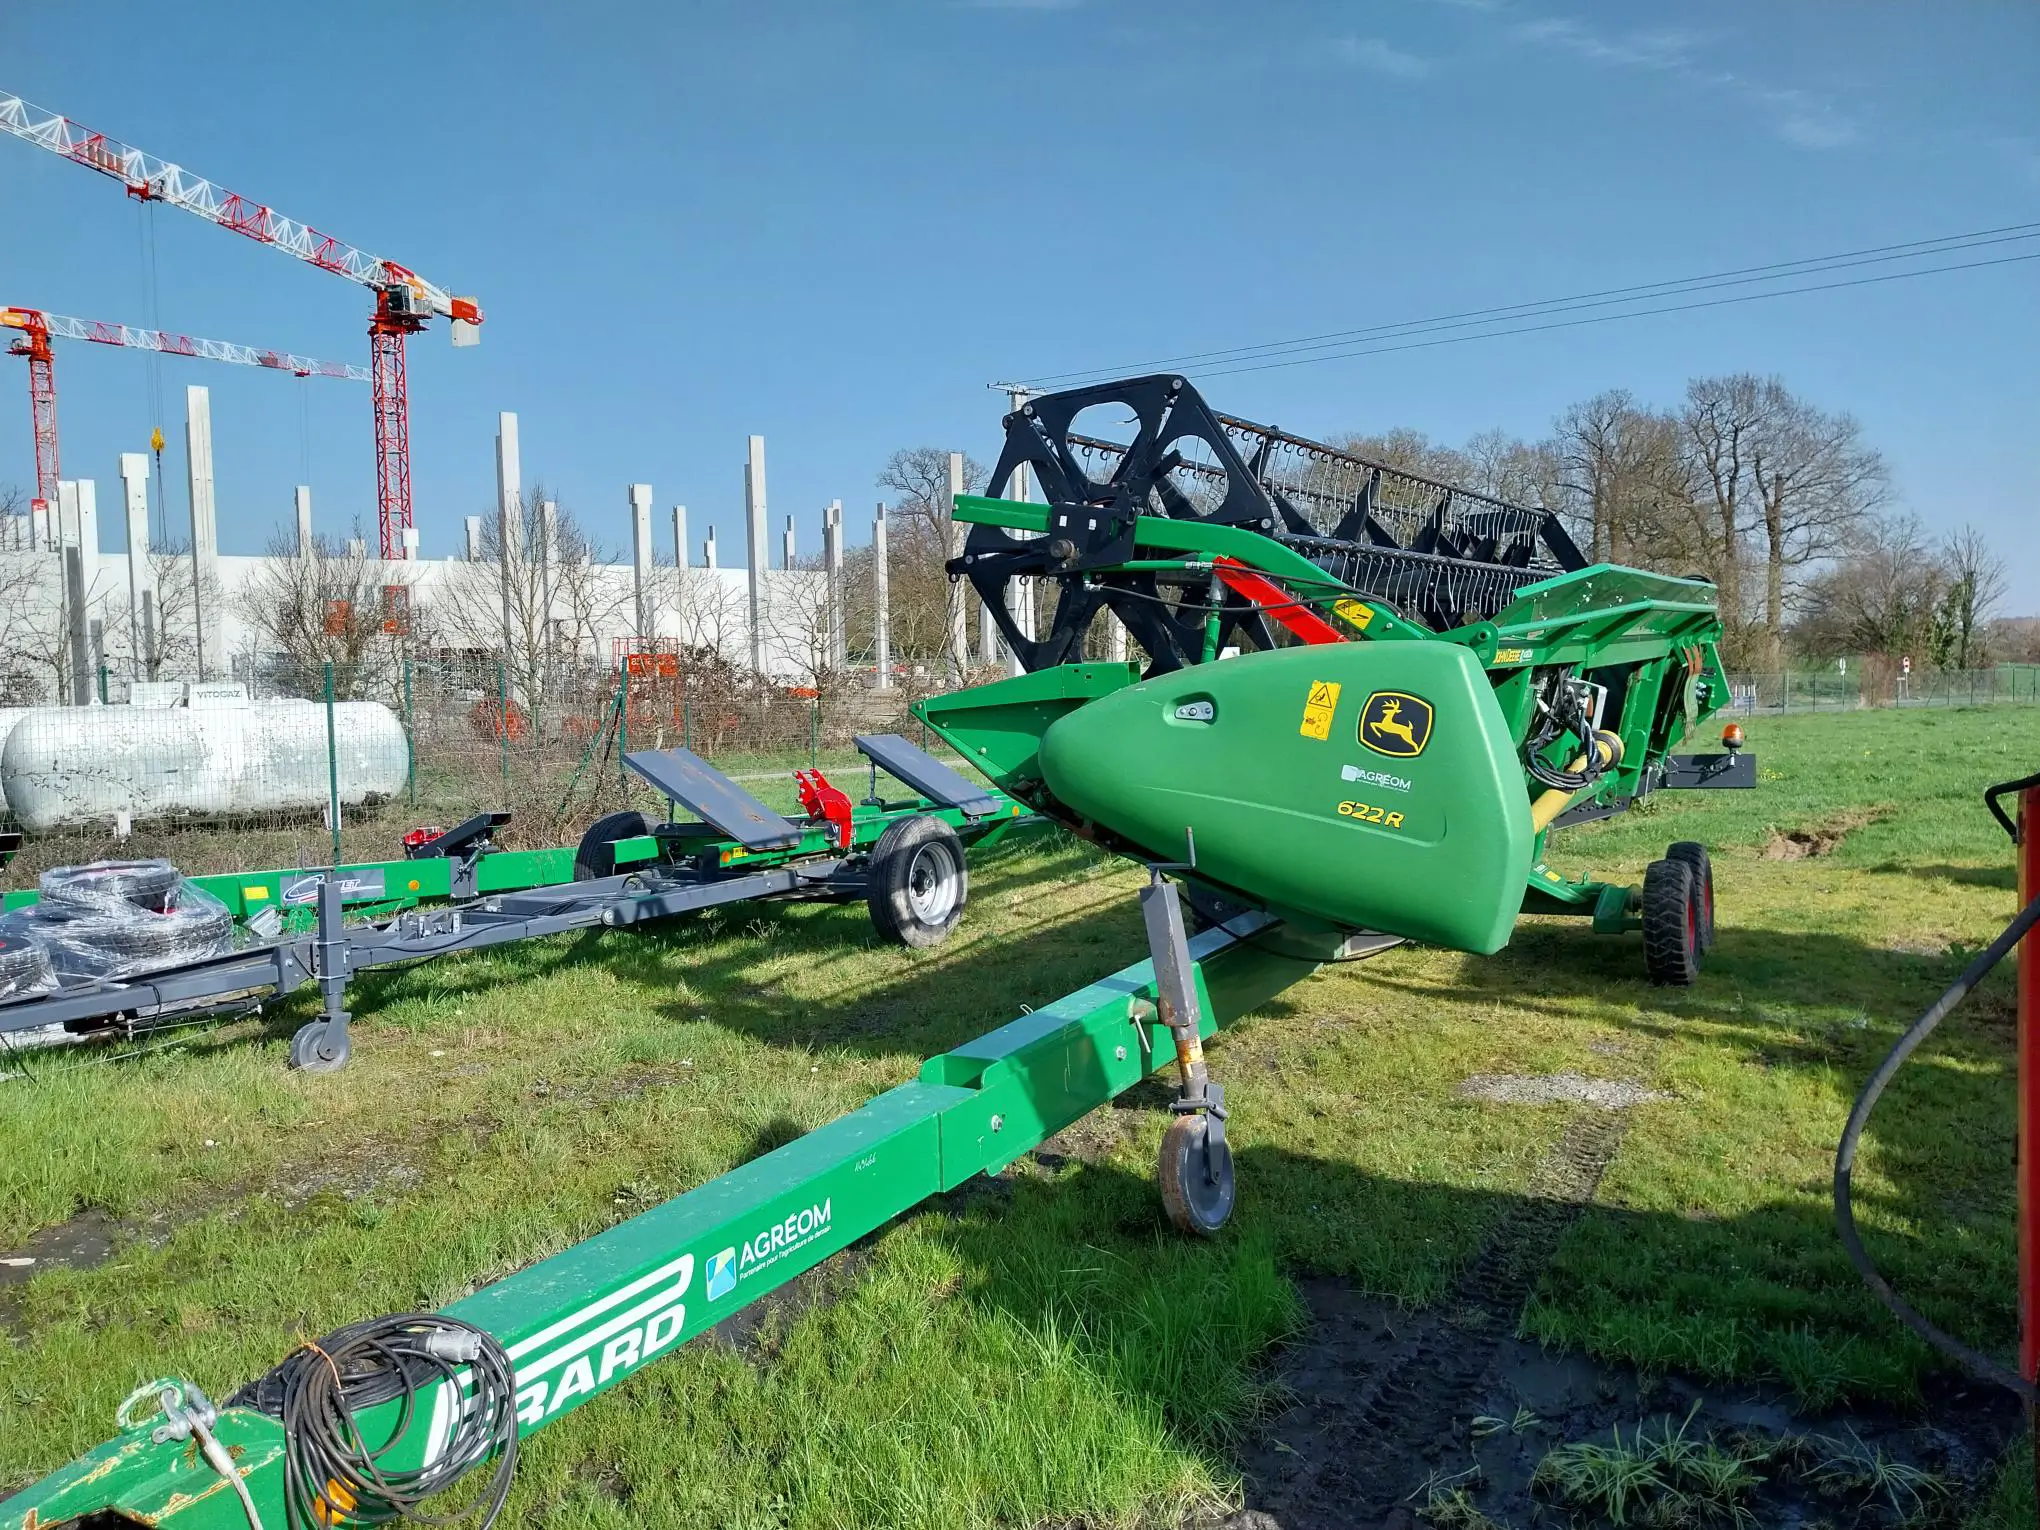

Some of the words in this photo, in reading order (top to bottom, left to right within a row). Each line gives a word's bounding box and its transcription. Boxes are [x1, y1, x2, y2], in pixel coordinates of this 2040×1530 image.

[197, 690, 241, 698] VITOGAZ
[739, 1197, 832, 1270] AGRÉOM
[767, 1255, 778, 1268] pour
